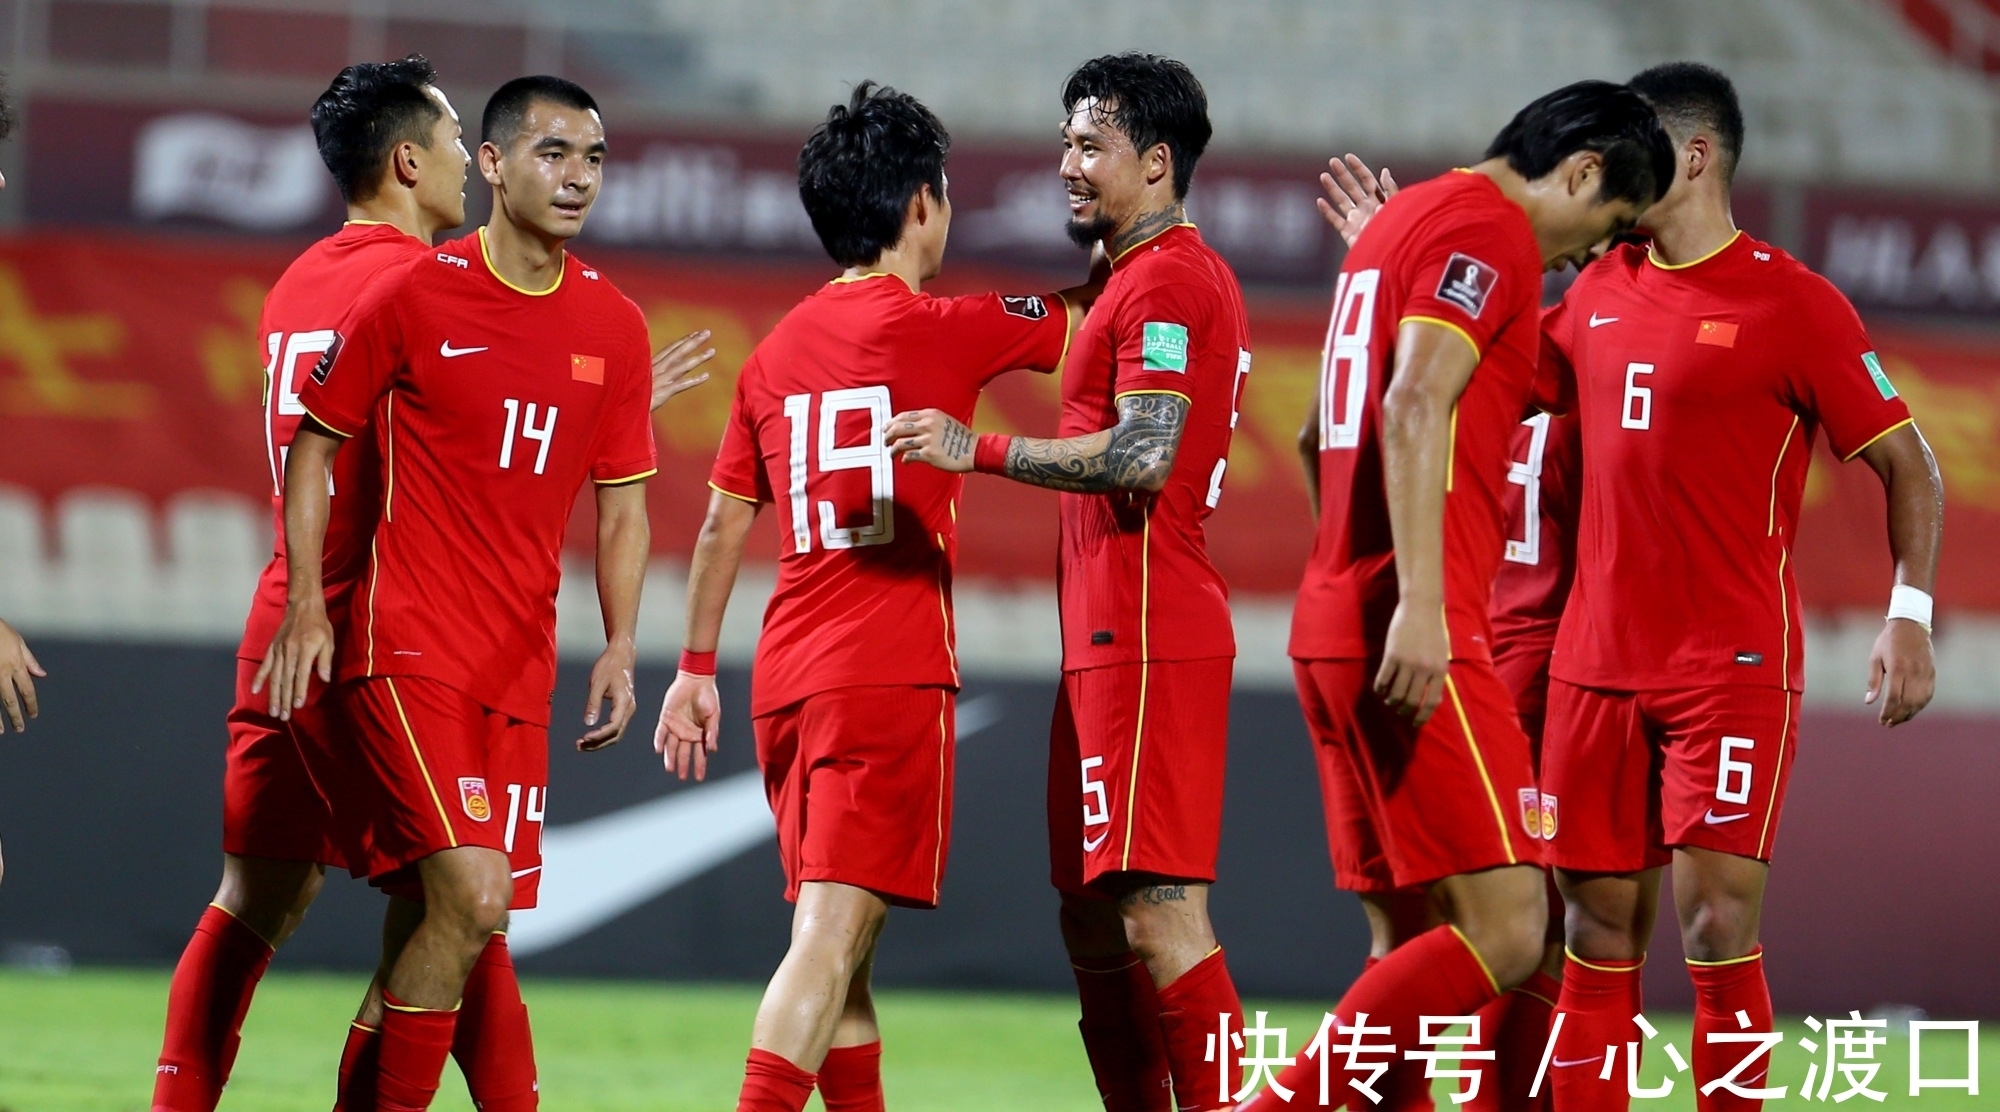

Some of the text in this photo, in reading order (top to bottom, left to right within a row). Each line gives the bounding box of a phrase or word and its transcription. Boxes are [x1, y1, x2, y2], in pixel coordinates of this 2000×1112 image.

[436, 252, 469, 269] CFA
[1318, 268, 1381, 451] 18
[1620, 361, 1655, 430] 6
[498, 398, 559, 475] 14
[783, 384, 895, 554] 19
[1081, 755, 1110, 826] 5
[1715, 735, 1755, 805] 6
[503, 783, 547, 855] 14
